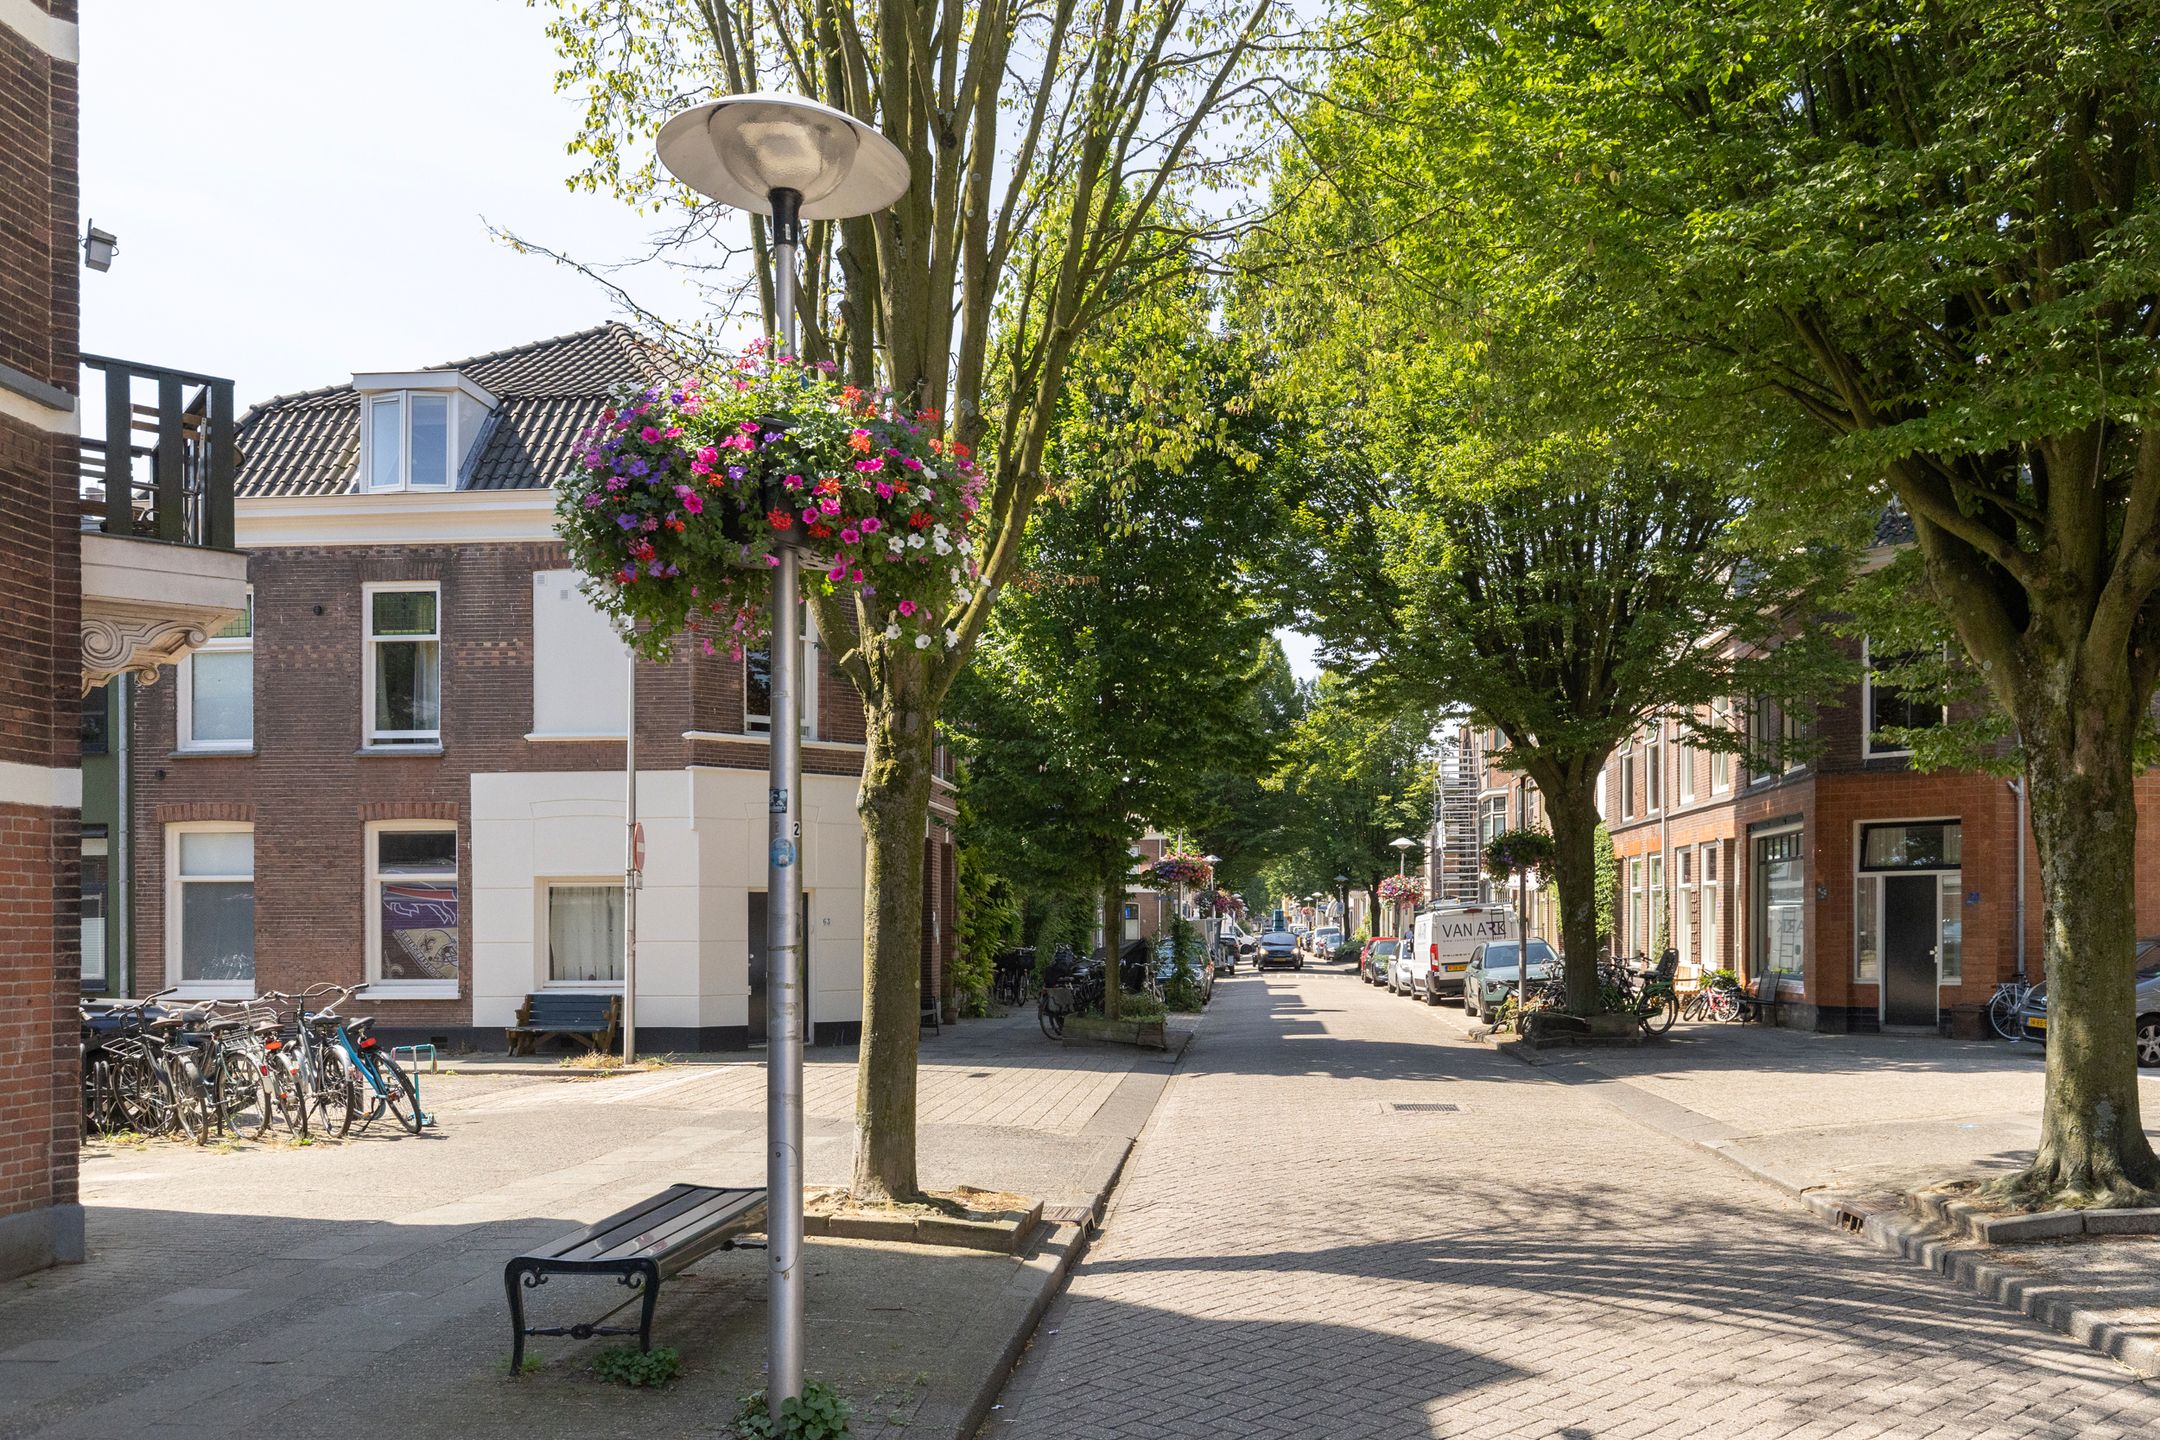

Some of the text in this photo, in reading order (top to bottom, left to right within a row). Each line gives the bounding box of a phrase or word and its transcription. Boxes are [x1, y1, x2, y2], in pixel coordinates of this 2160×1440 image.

[793, 823, 800, 836] 2
[1442, 921, 1506, 938] VAN ARK
